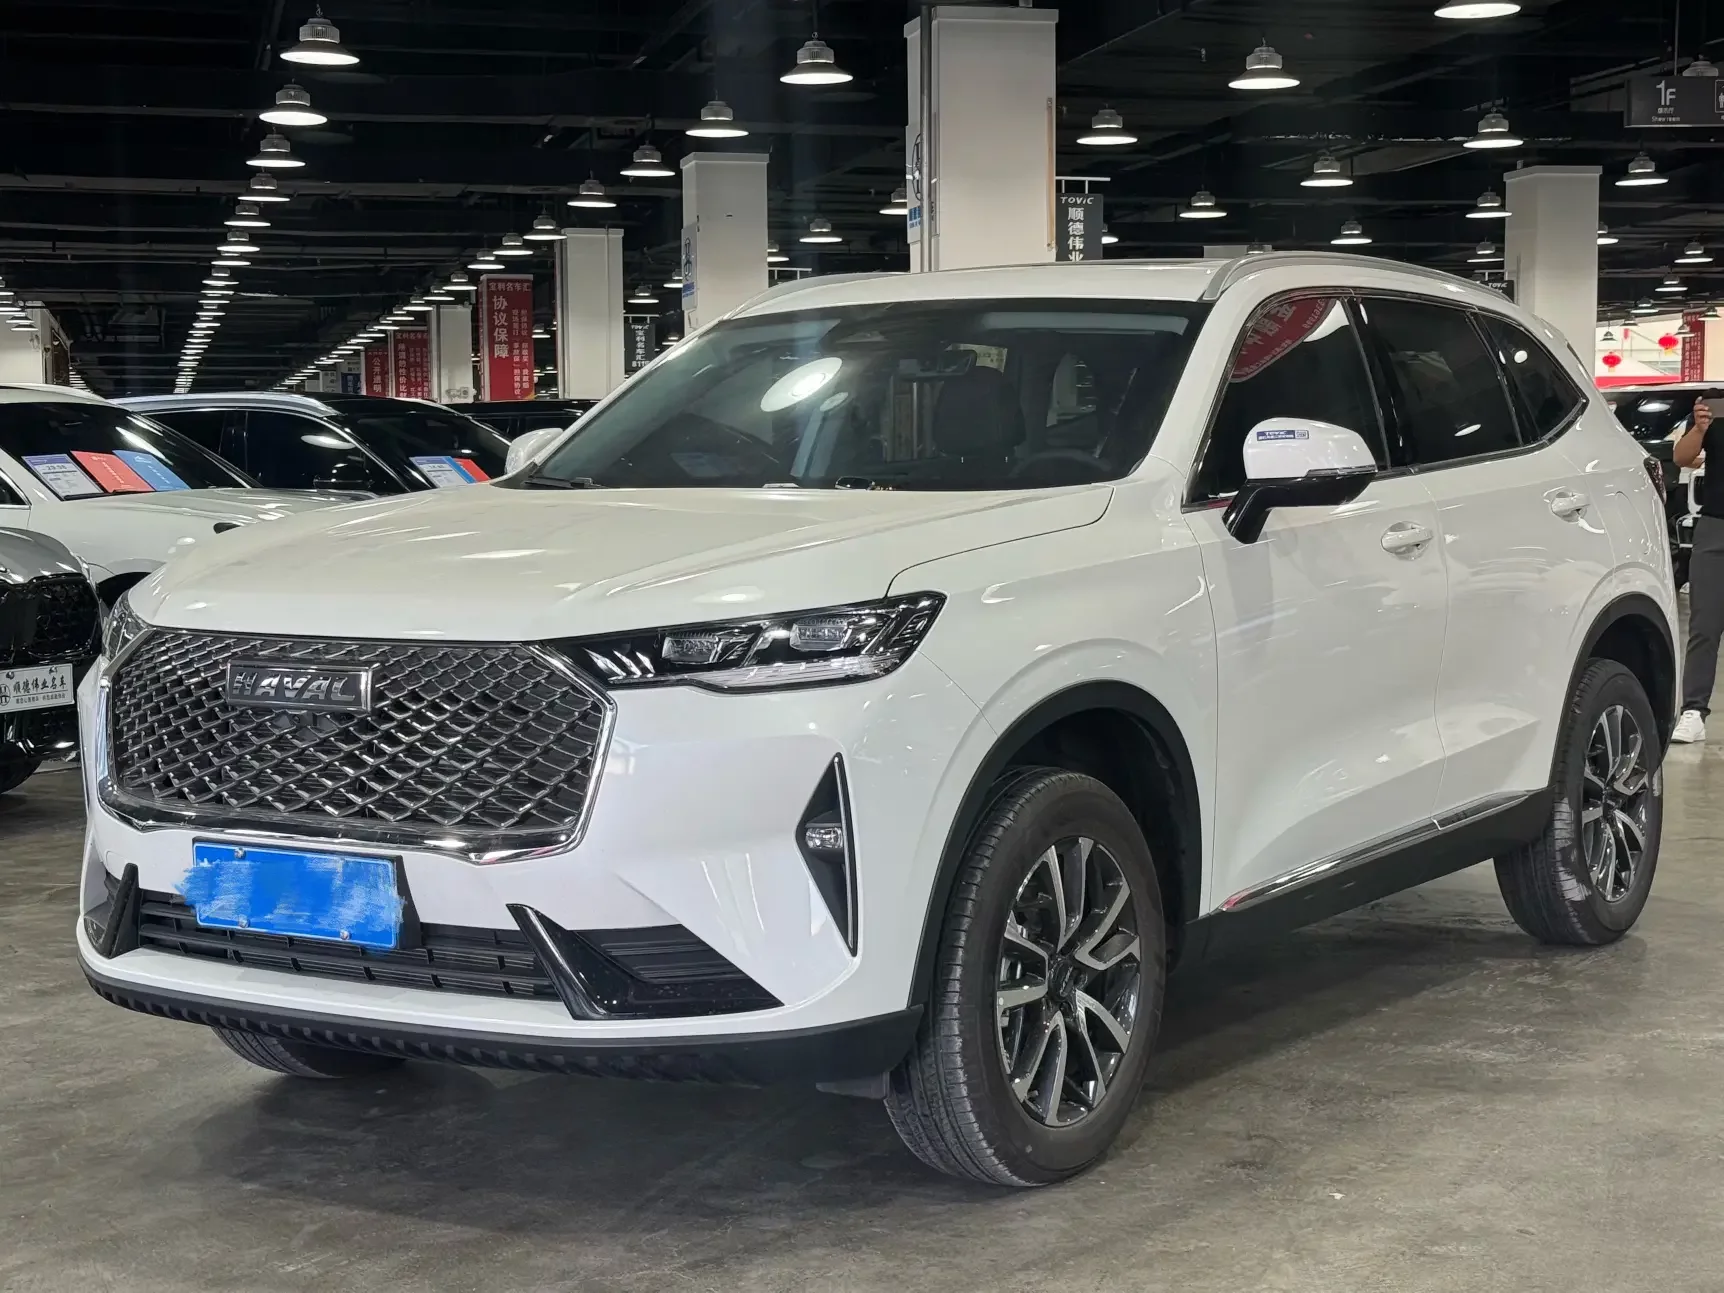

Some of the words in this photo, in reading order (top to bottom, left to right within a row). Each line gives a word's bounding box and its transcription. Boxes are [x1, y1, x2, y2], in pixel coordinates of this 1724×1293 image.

[1656, 80, 1676, 106] 1F
[1067, 207, 1085, 262] 顺德伟业
[492, 295, 510, 359] 协议保障
[13, 675, 66, 694] 顺德伟业名车
[232, 672, 355, 701] HAVAL
